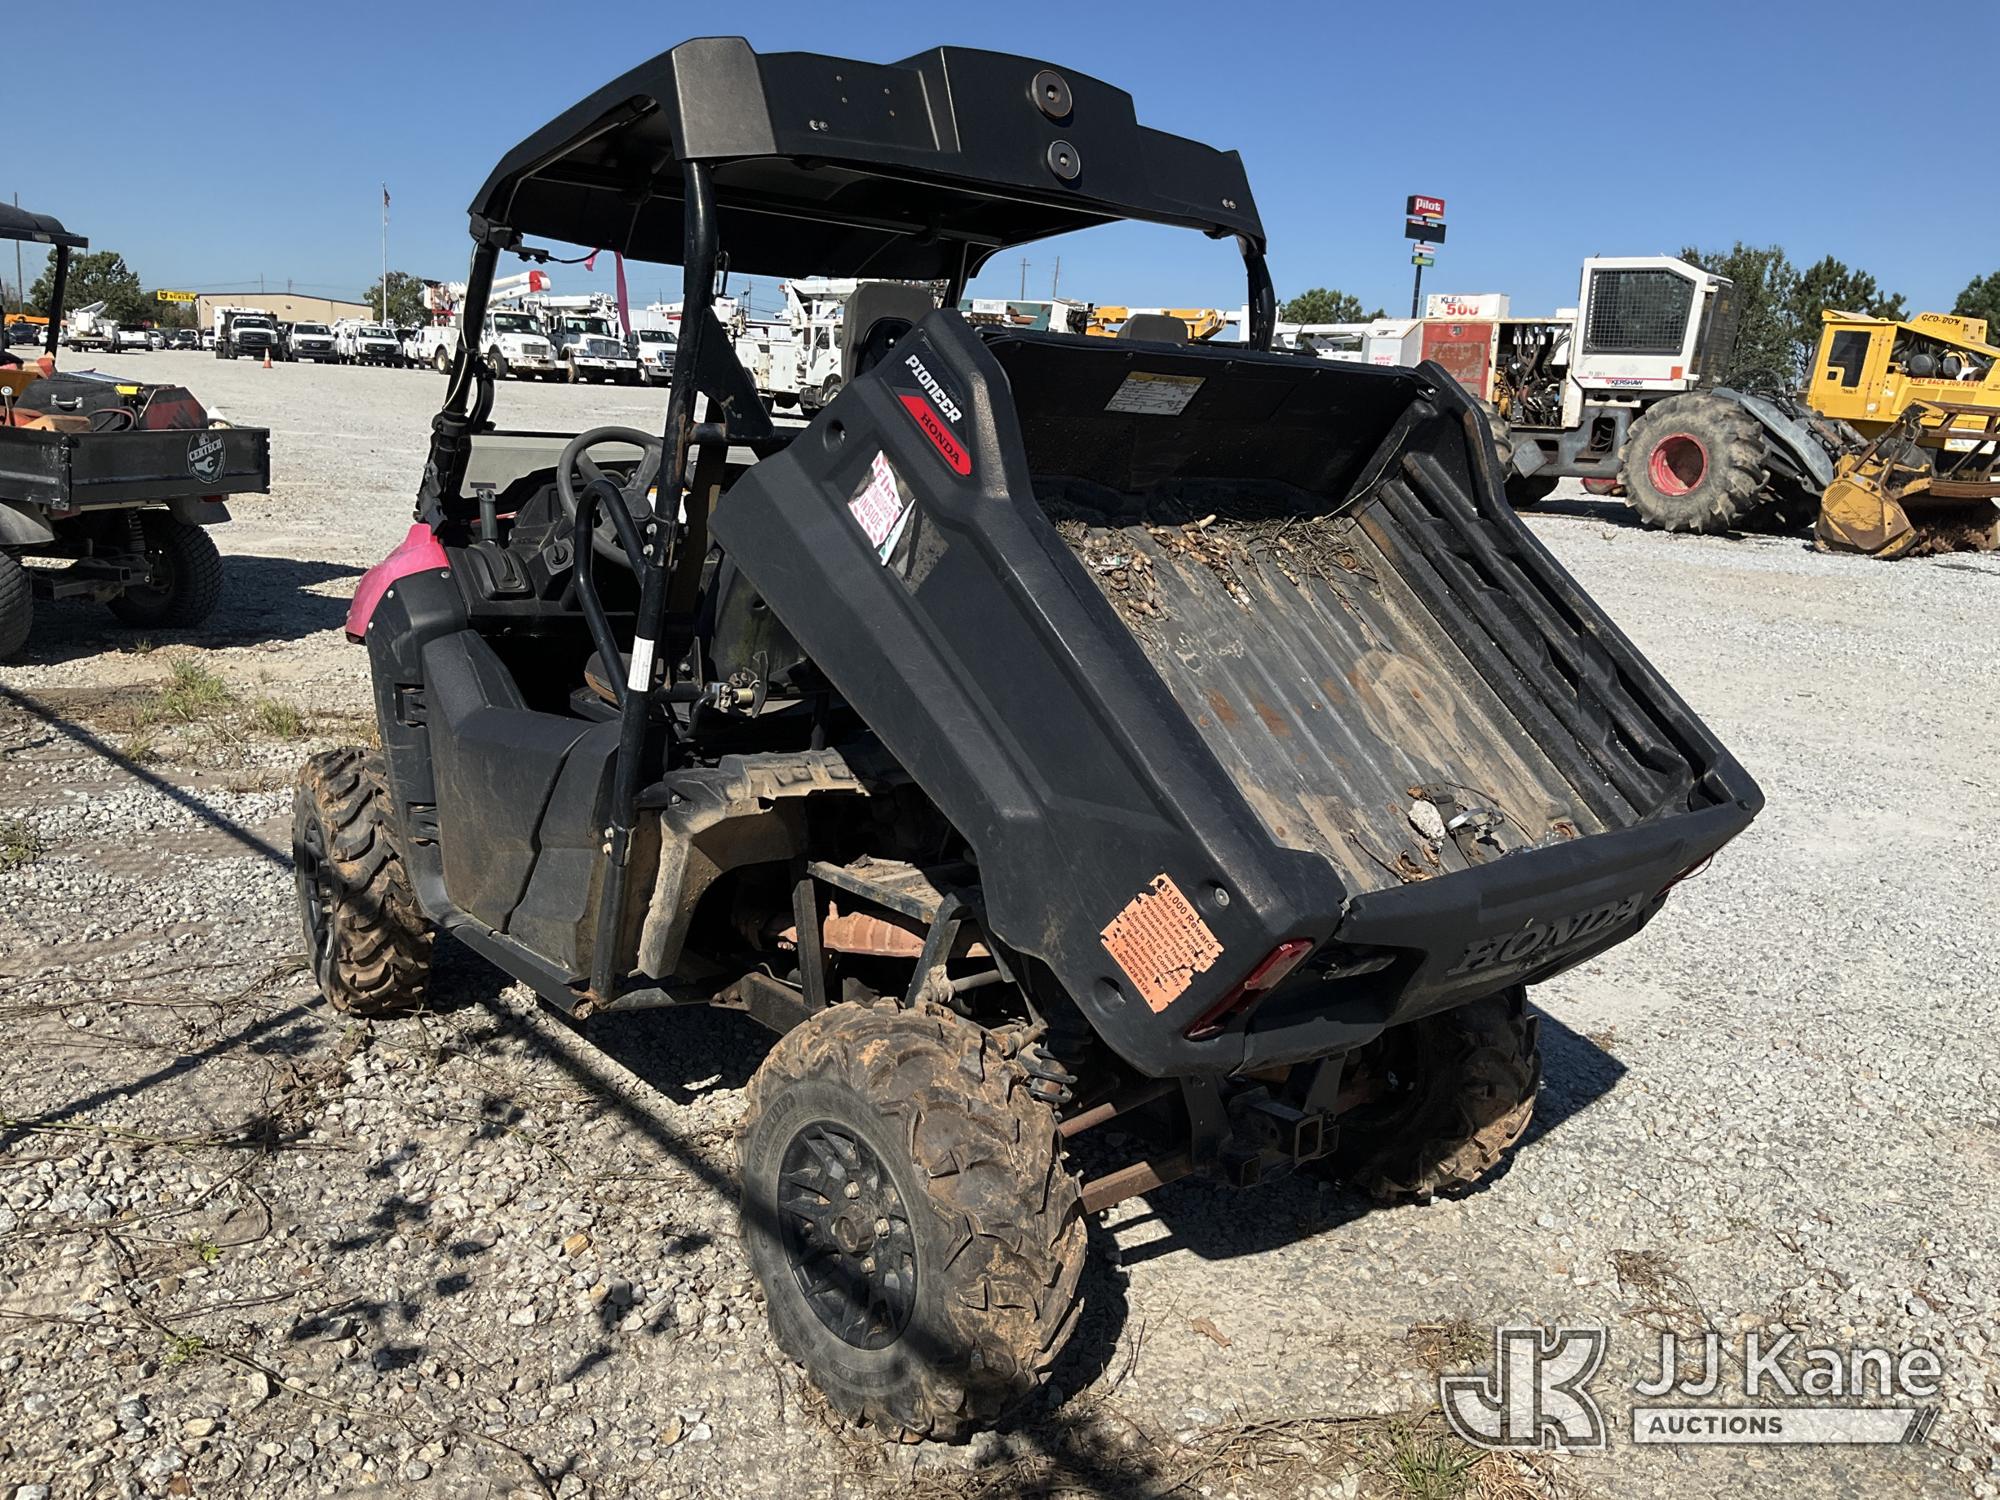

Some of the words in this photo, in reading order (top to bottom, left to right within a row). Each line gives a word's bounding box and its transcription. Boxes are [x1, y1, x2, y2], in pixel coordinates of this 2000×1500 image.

[905, 354, 962, 423] PIONEER
[921, 413, 960, 465] HONDA
[859, 495, 884, 530] INSIDE
[1153, 889, 1171, 910] ffered
[1199, 948, 1211, 960] nd
[1160, 883, 1188, 916] $1,000
[1184, 913, 1215, 951] Reward
[1448, 891, 1644, 976] HONDA
